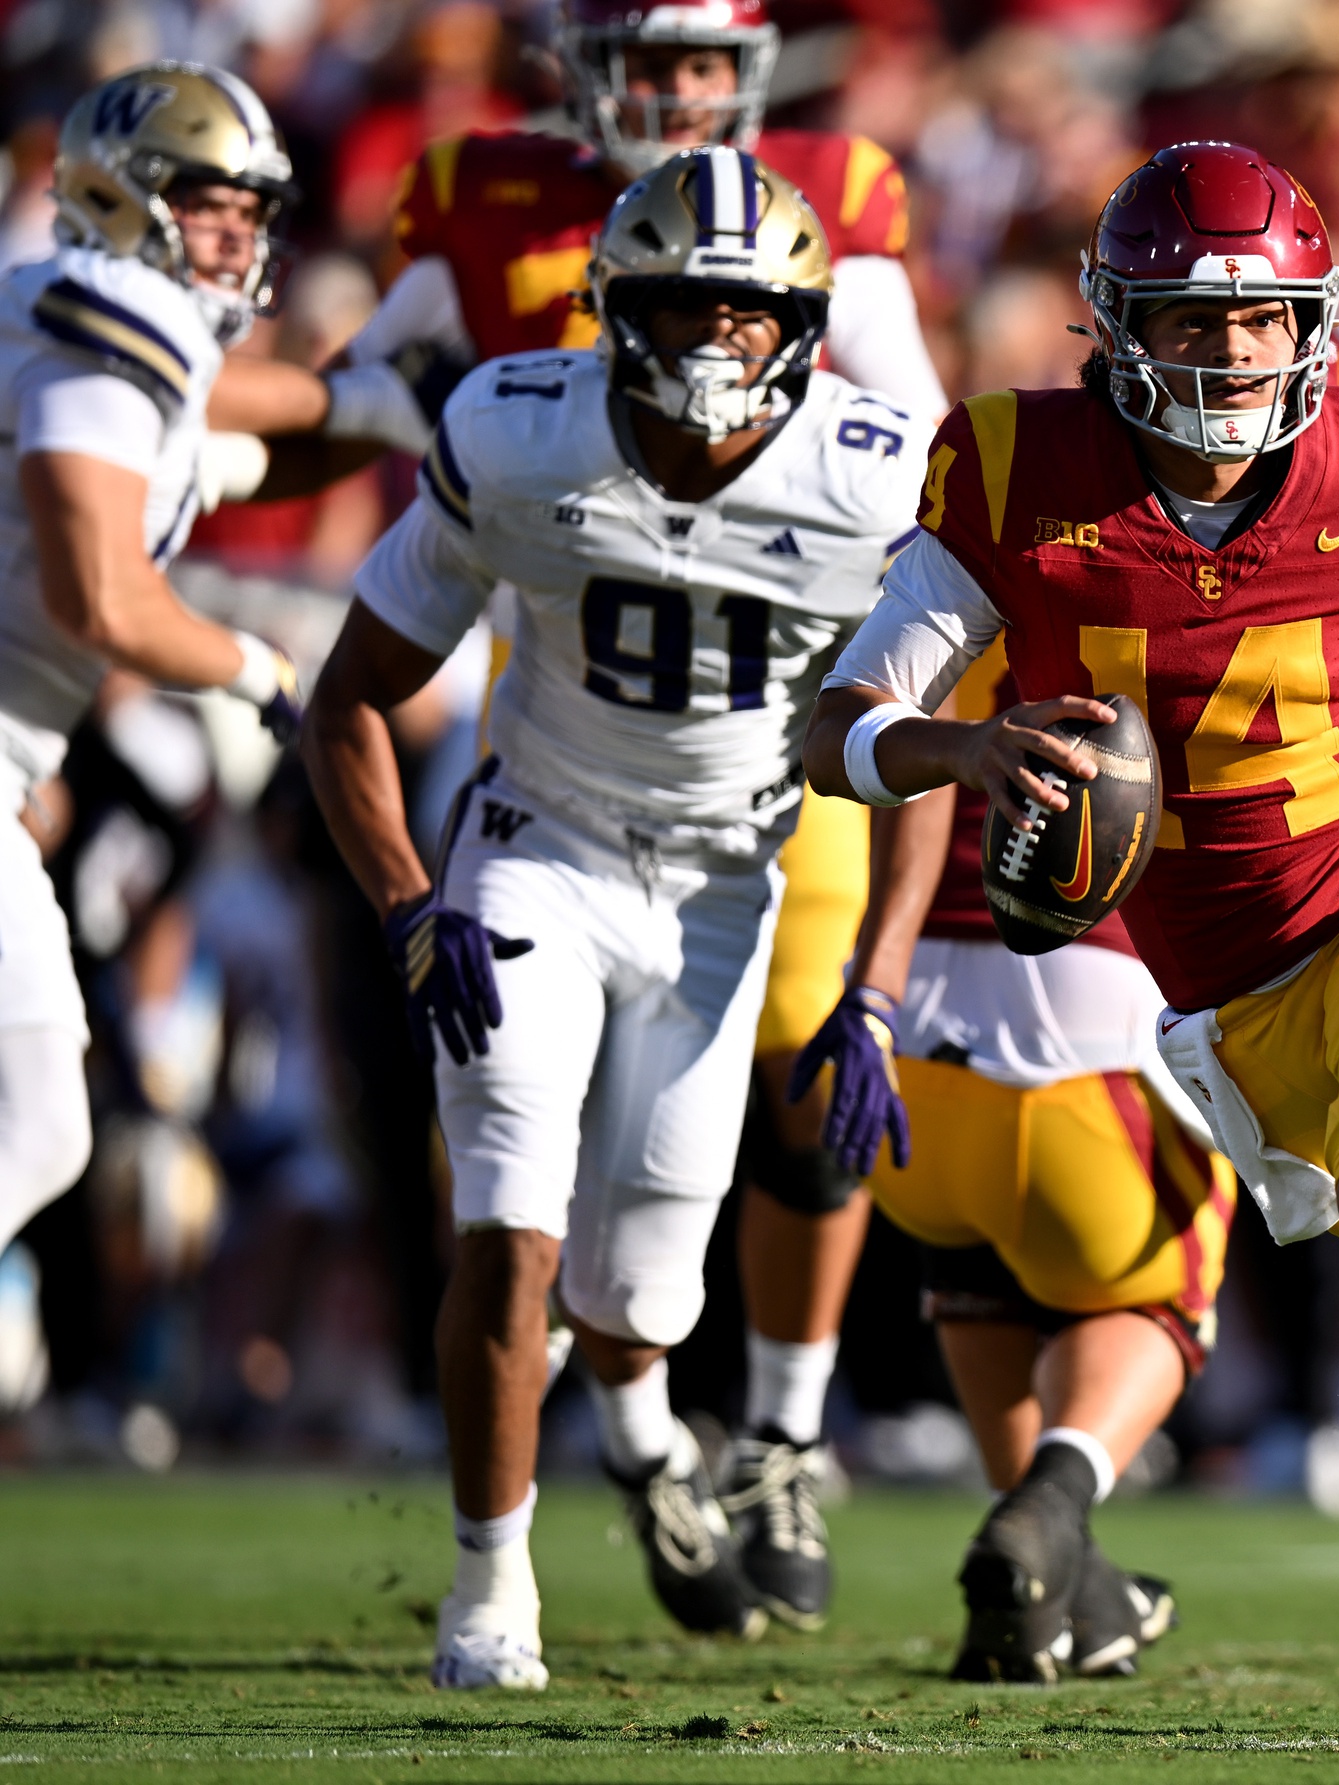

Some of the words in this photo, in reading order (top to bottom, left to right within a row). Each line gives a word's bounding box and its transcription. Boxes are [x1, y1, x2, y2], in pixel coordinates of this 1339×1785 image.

[664, 514, 696, 536] W
[1198, 565, 1222, 600] SC
[581, 576, 770, 713] 91
[481, 800, 535, 842] W
